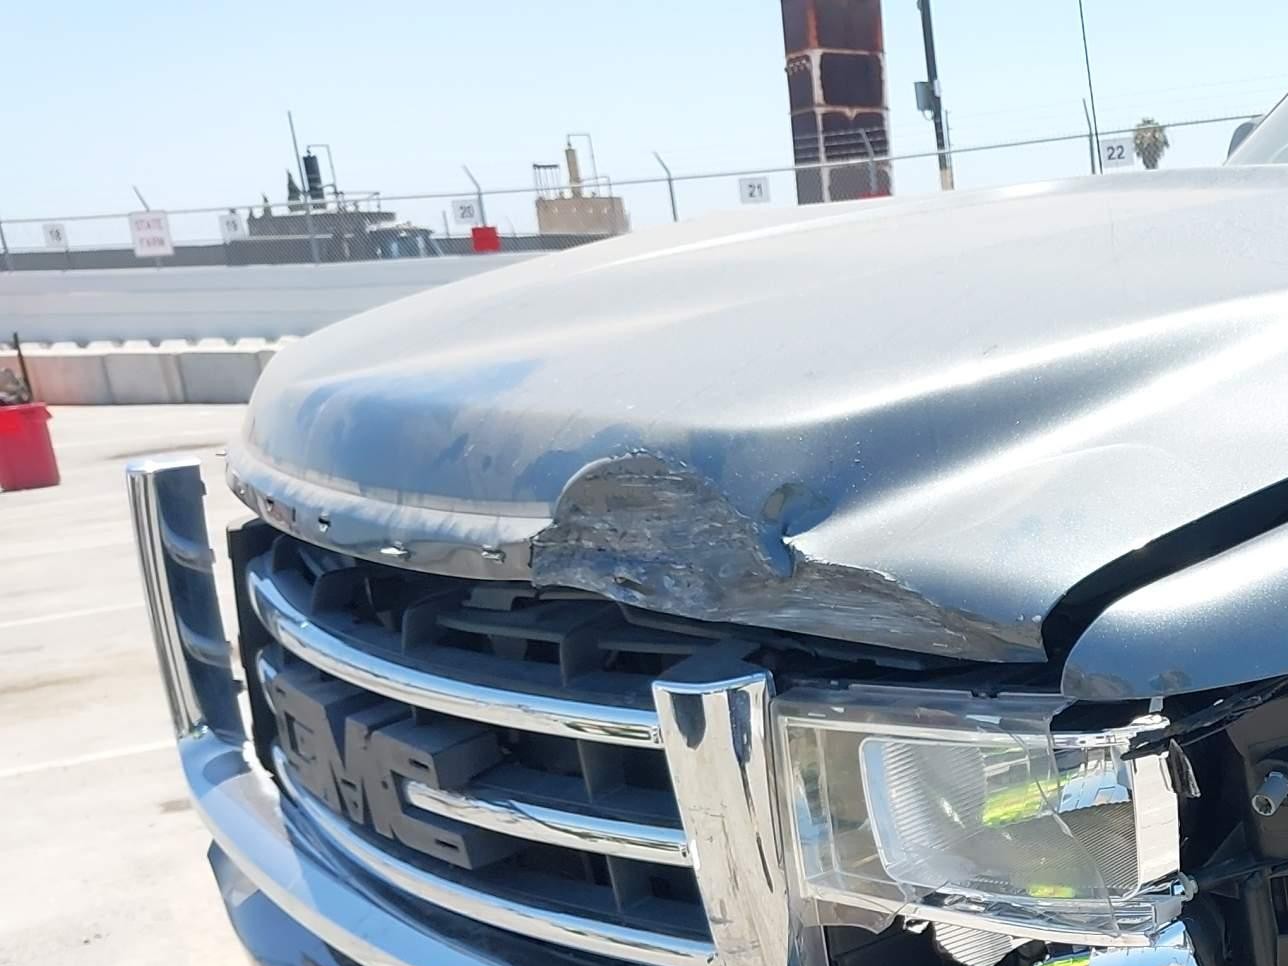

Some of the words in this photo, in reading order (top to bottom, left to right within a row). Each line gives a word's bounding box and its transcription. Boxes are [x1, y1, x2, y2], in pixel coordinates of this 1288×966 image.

[1106, 145, 1125, 160] 22
[748, 184, 763, 198] 21
[272, 670, 478, 871] GMC
